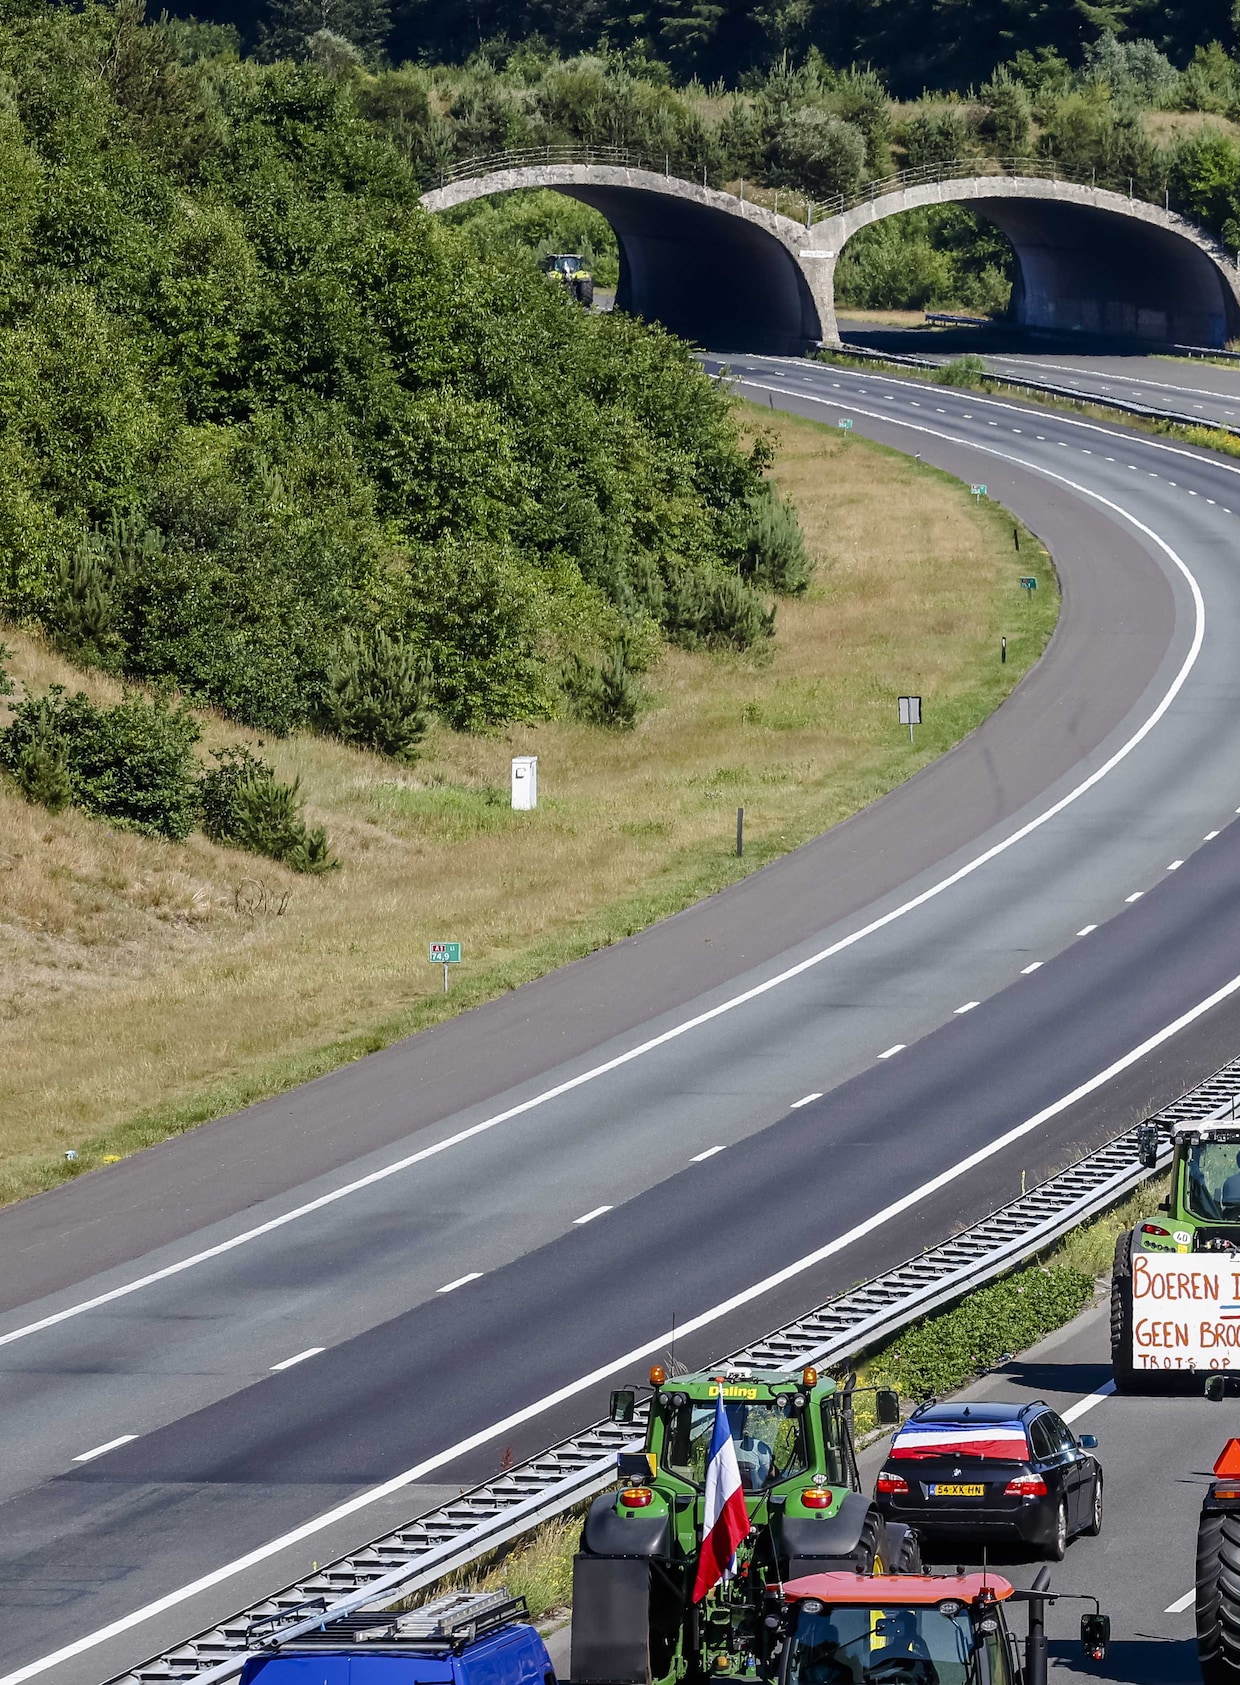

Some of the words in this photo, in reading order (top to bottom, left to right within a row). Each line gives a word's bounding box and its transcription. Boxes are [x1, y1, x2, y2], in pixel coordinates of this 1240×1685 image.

[1134, 1256, 1219, 1300] BOEREN
[1135, 1318, 1189, 1347] GEEN
[1138, 1354, 1197, 1370] TROTS
[1210, 1358, 1231, 1370] OP
[708, 1386, 757, 1400] Daling
